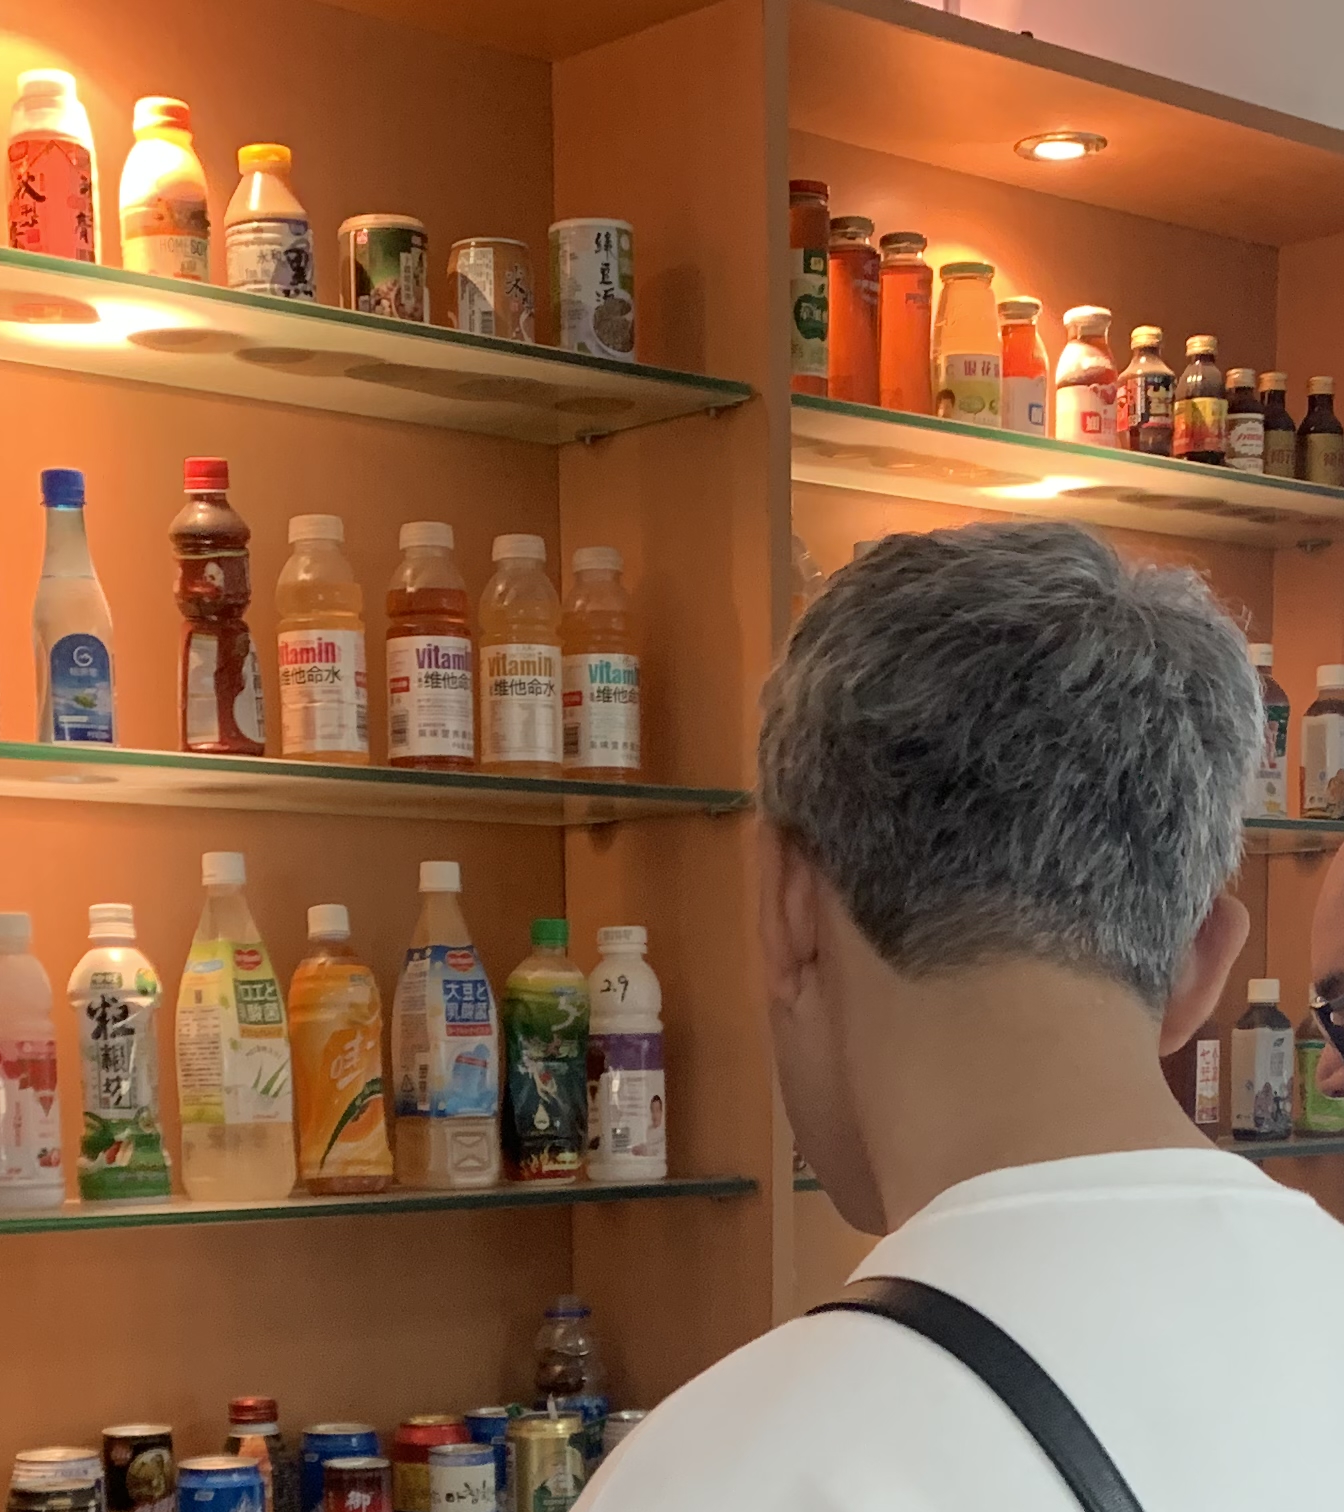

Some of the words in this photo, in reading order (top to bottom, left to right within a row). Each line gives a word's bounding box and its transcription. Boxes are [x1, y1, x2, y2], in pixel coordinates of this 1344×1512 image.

[488, 651, 553, 678] vitamin
[494, 678, 556, 698] 维他命水
[445, 982, 487, 1001] 大豆と
[600, 974, 630, 1003] 2.9
